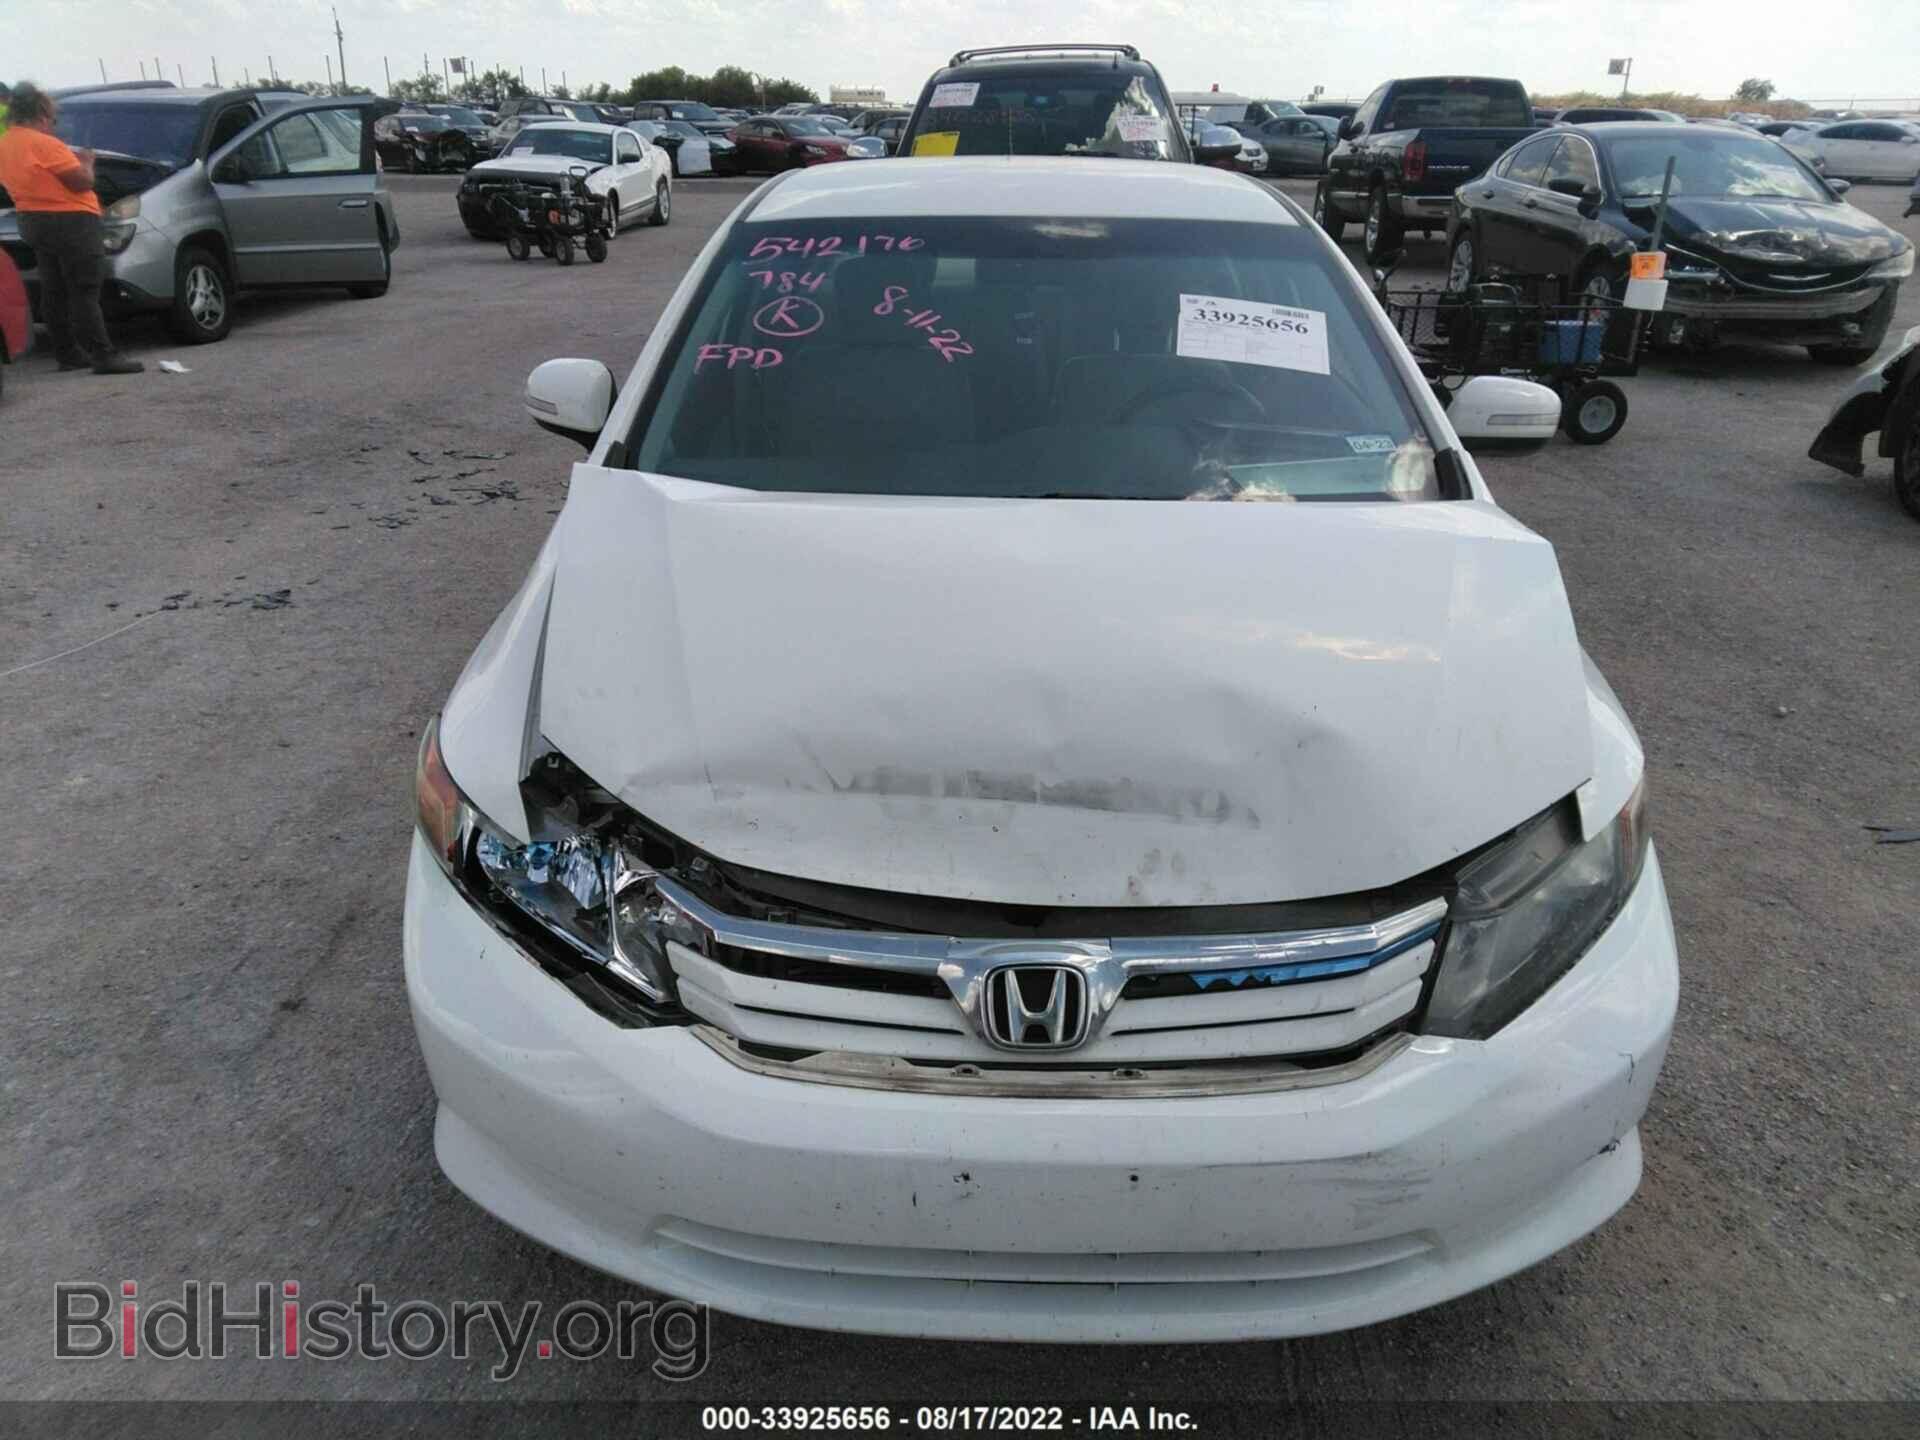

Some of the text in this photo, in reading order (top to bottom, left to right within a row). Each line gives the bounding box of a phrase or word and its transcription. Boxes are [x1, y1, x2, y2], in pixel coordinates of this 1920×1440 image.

[749, 271, 826, 293] 784
[770, 299, 800, 329] K
[1193, 308, 1309, 334] 33925656
[694, 344, 784, 374] FPD
